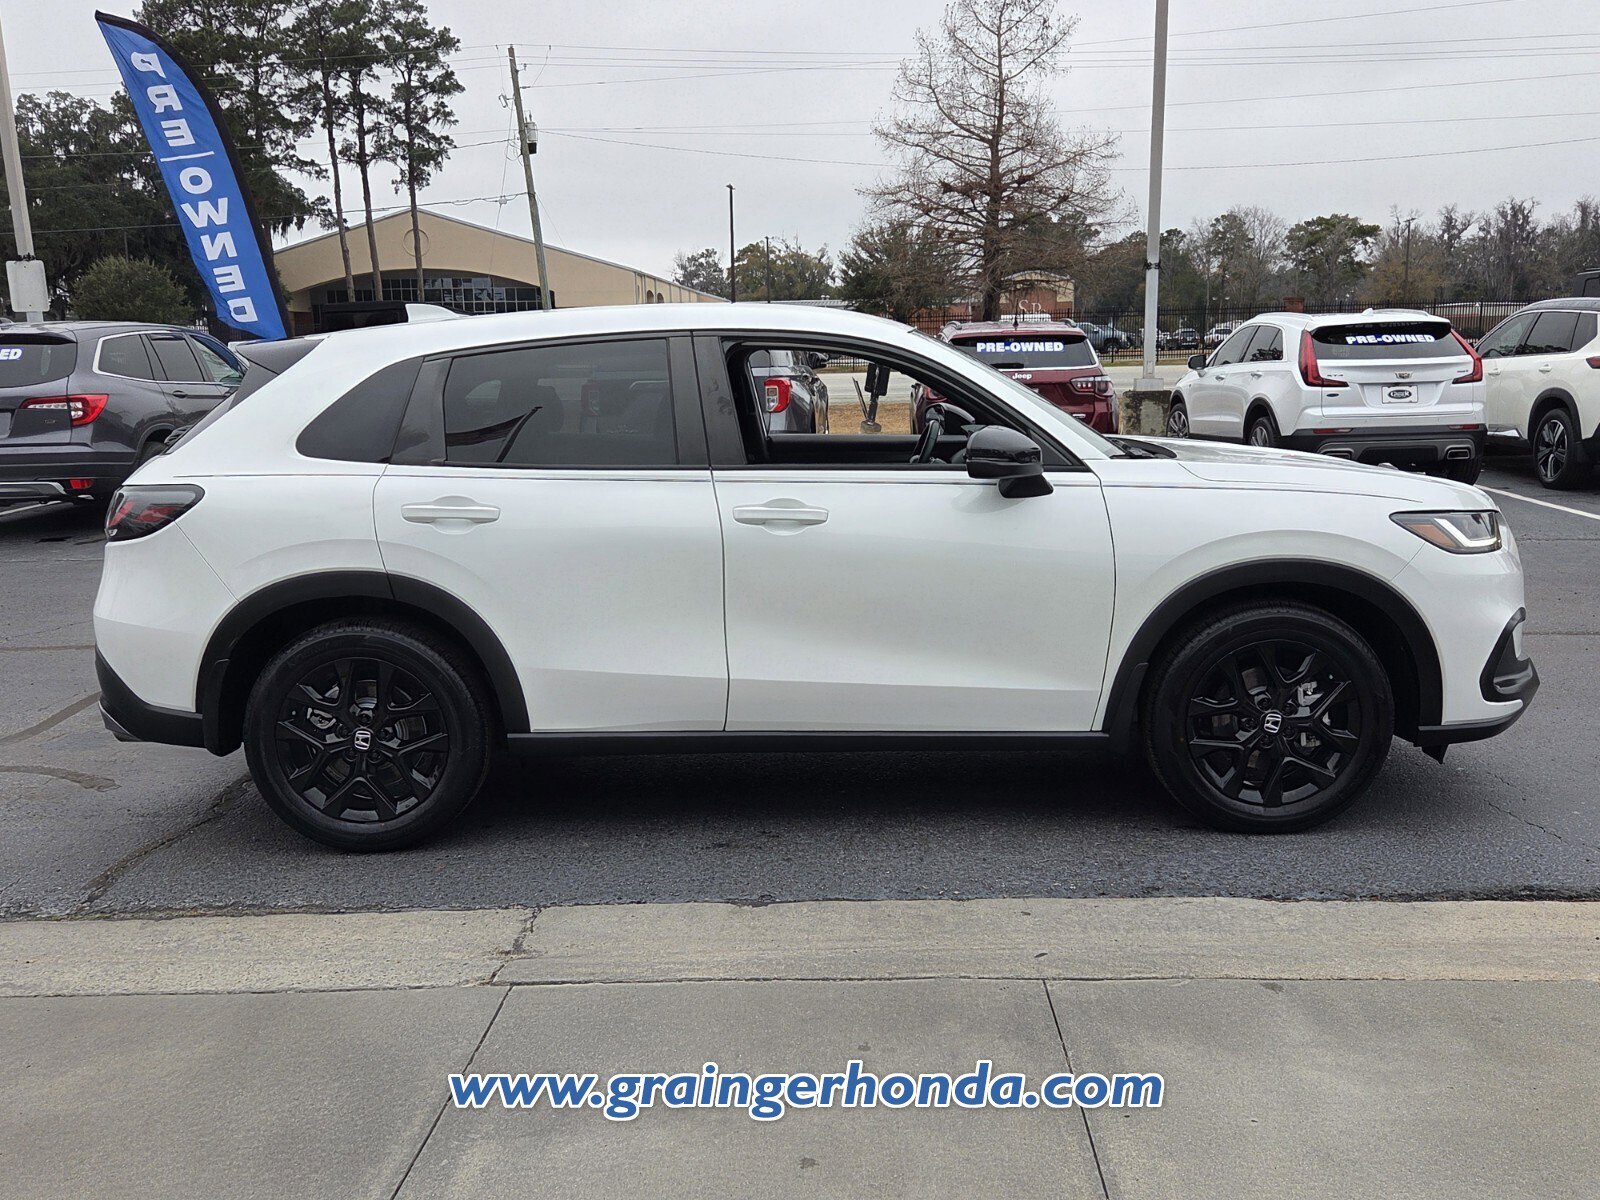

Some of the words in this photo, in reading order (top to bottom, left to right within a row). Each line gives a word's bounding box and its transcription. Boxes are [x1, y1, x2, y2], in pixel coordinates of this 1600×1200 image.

[1345, 334, 1436, 345] PRE-OWNED
[976, 341, 1064, 352] PRE-OWNED
[1012, 372, 1032, 380] Jeep
